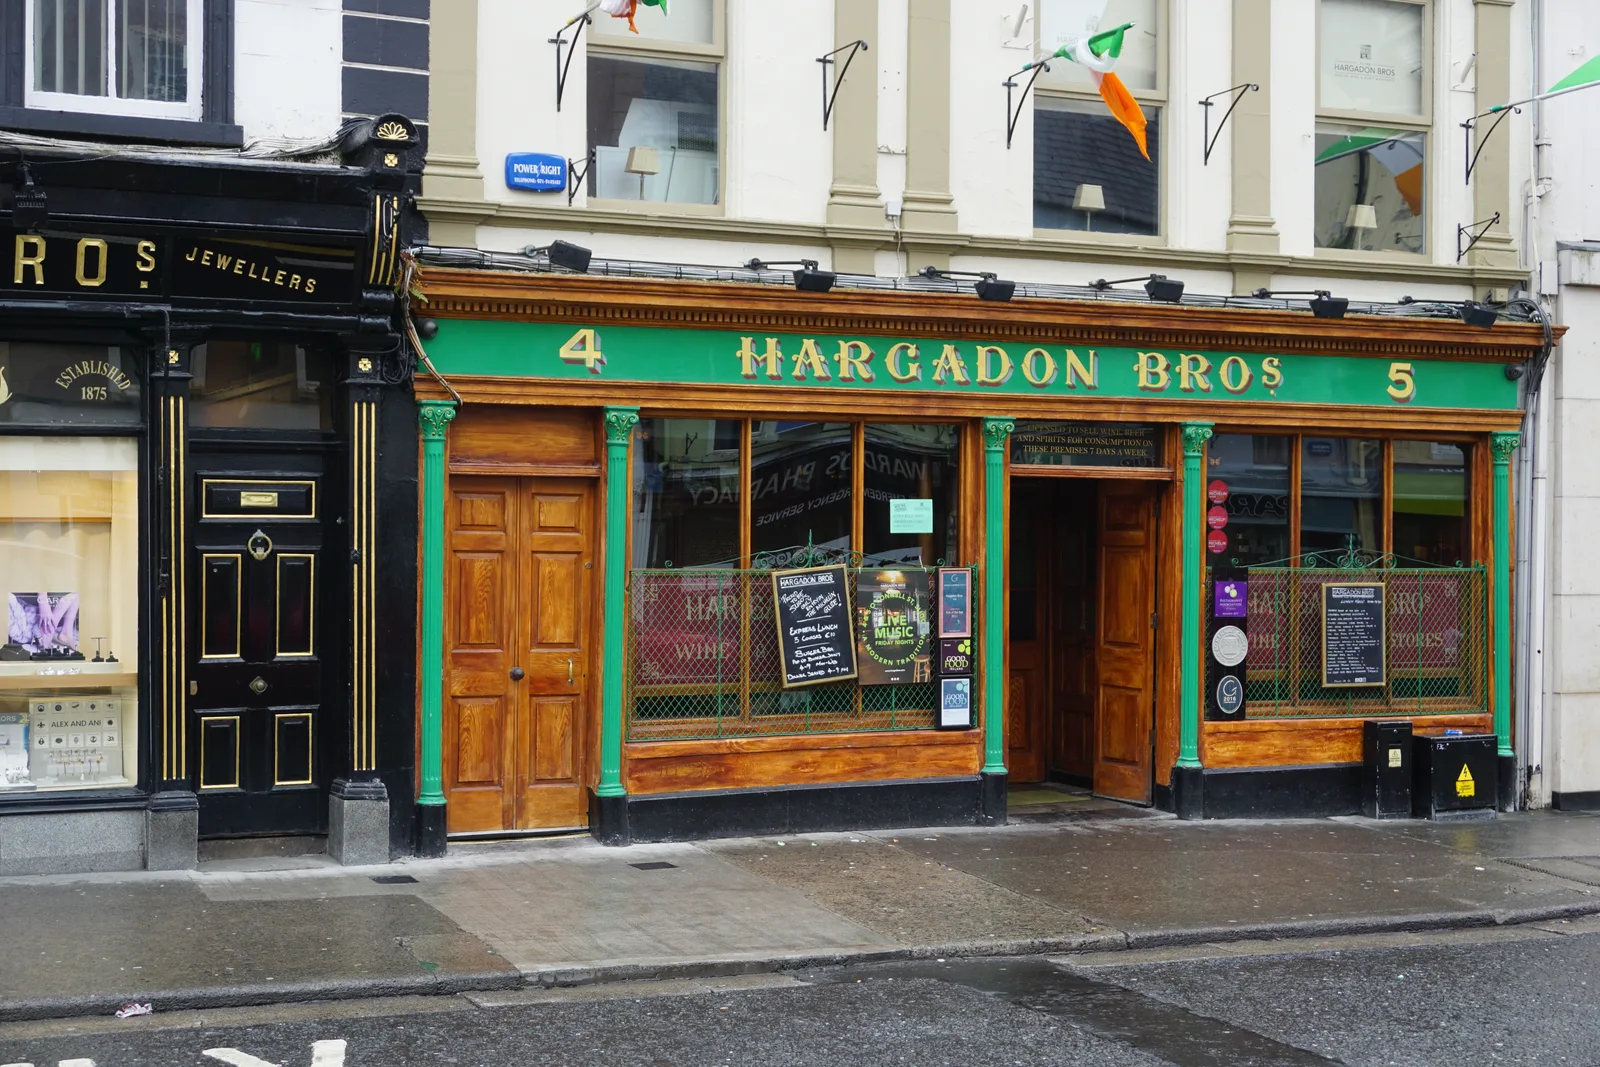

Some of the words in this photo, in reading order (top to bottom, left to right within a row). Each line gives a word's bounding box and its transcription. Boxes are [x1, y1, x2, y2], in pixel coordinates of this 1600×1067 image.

[1334, 63, 1376, 75] HARGADON
[1377, 67, 1395, 76] BROS
[513, 163, 538, 173] POWER
[540, 165, 561, 175] RIGHT
[185, 246, 318, 294] JEWELLERS
[558, 328, 607, 374] 4
[735, 336, 1099, 389] HARGADON
[55, 359, 132, 391] ESTABLISHED
[1386, 362, 1418, 403] 5
[80, 385, 108, 400] 1875
[1027, 424, 1066, 433] LICENSED
[1079, 427, 1099, 435] SELL
[1016, 434, 1035, 442] AND
[1036, 436, 1066, 444] SPIRITS
[1067, 436, 1083, 444] FOR
[1084, 437, 1141, 447] CONSUMPTION
[1142, 439, 1153, 447] ON
[1022, 444, 1049, 453] THESE
[1050, 446, 1088, 454] PREMISES
[780, 576, 816, 587] HARGADON
[817, 574, 834, 583] BROS
[882, 615, 907, 626] LIVE
[817, 623, 838, 632] LUNCH
[874, 626, 914, 638] MUSIC
[865, 644, 893, 666] MODERN
[896, 634, 926, 666] TRADITION
[944, 660, 969, 668] FOOD
[944, 697, 967, 705] FOOD
[51, 720, 69, 728] ALEX
[70, 719, 87, 727] AND
[88, 719, 102, 727] ANI
